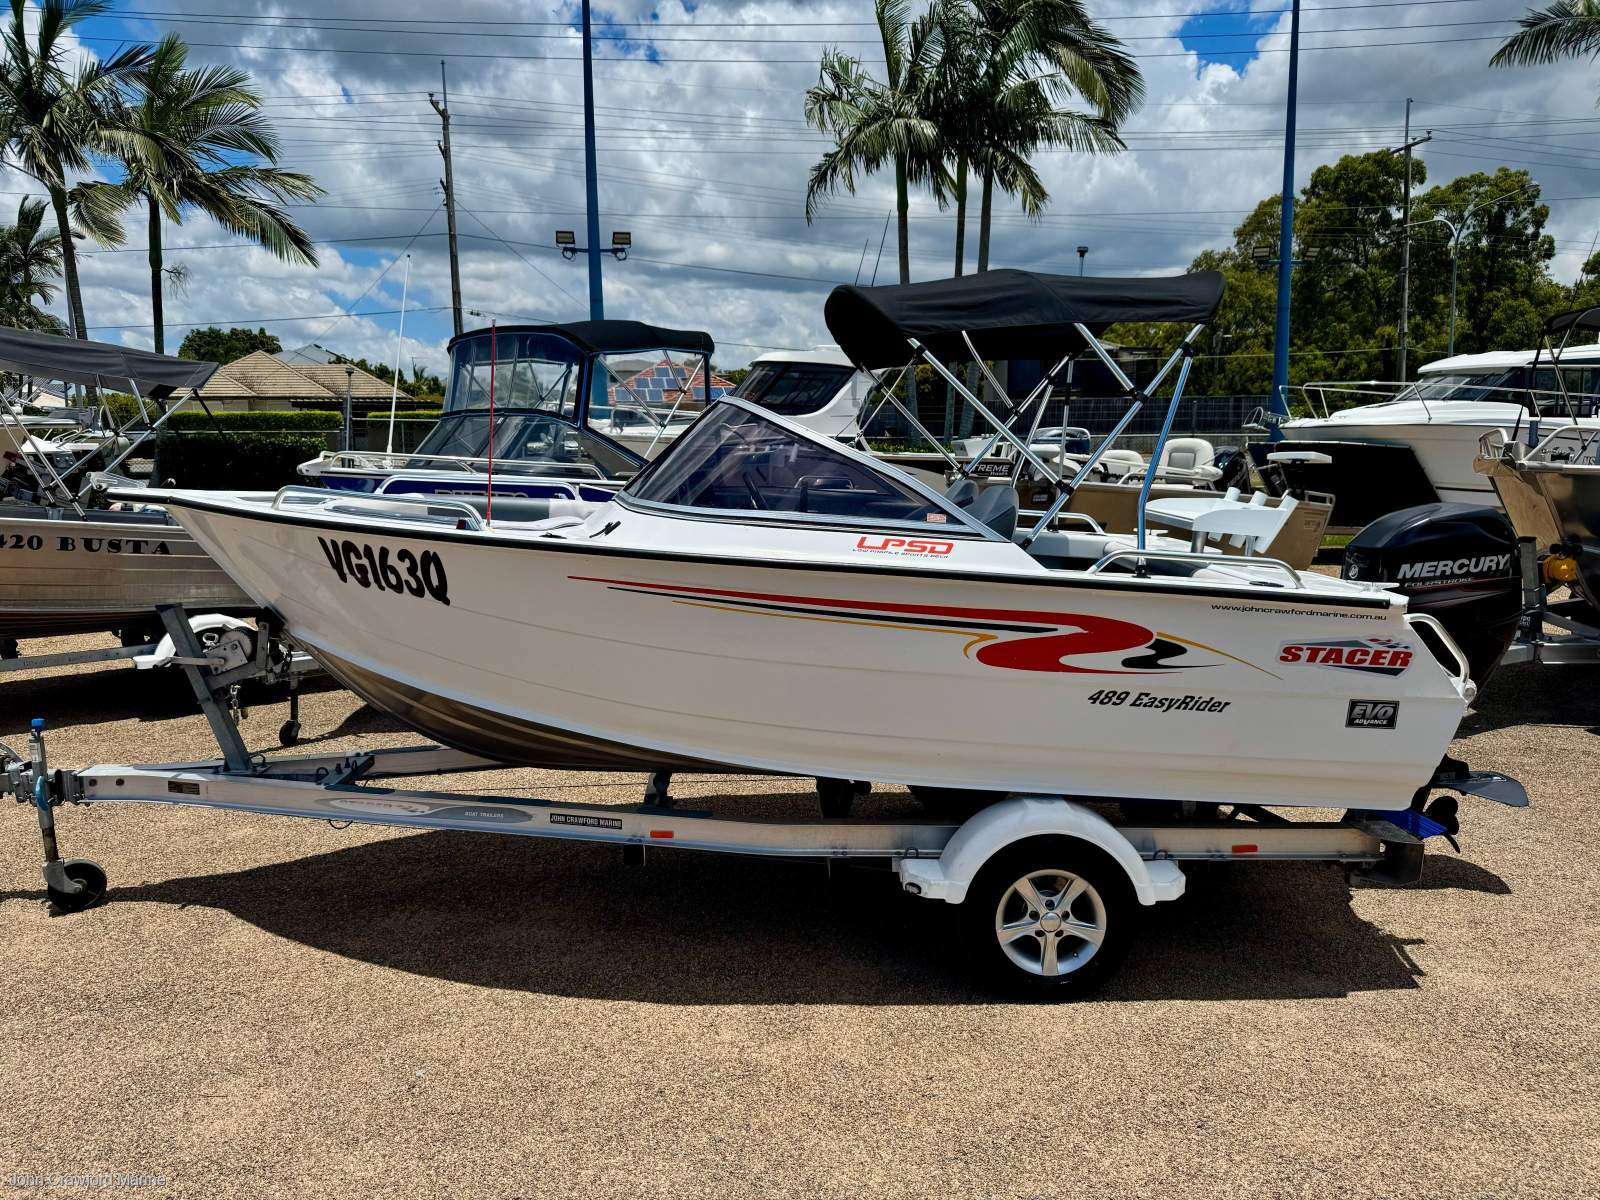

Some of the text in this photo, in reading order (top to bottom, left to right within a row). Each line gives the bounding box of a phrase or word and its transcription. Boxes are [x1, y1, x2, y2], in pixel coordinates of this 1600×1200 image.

[56, 536, 172, 555] BUSTA
[856, 536, 954, 555] LPSD
[317, 536, 451, 606] VG163Q
[1397, 553, 1510, 579] MERCURY
[1211, 603, 1387, 621] www.johncrawfordmarine.com.au
[1279, 645, 1413, 668] STACER
[1087, 689, 1232, 713] 489 EasyRider
[1350, 703, 1396, 719] EVO
[551, 814, 622, 828] JOHN CRAWFORD MARINE
